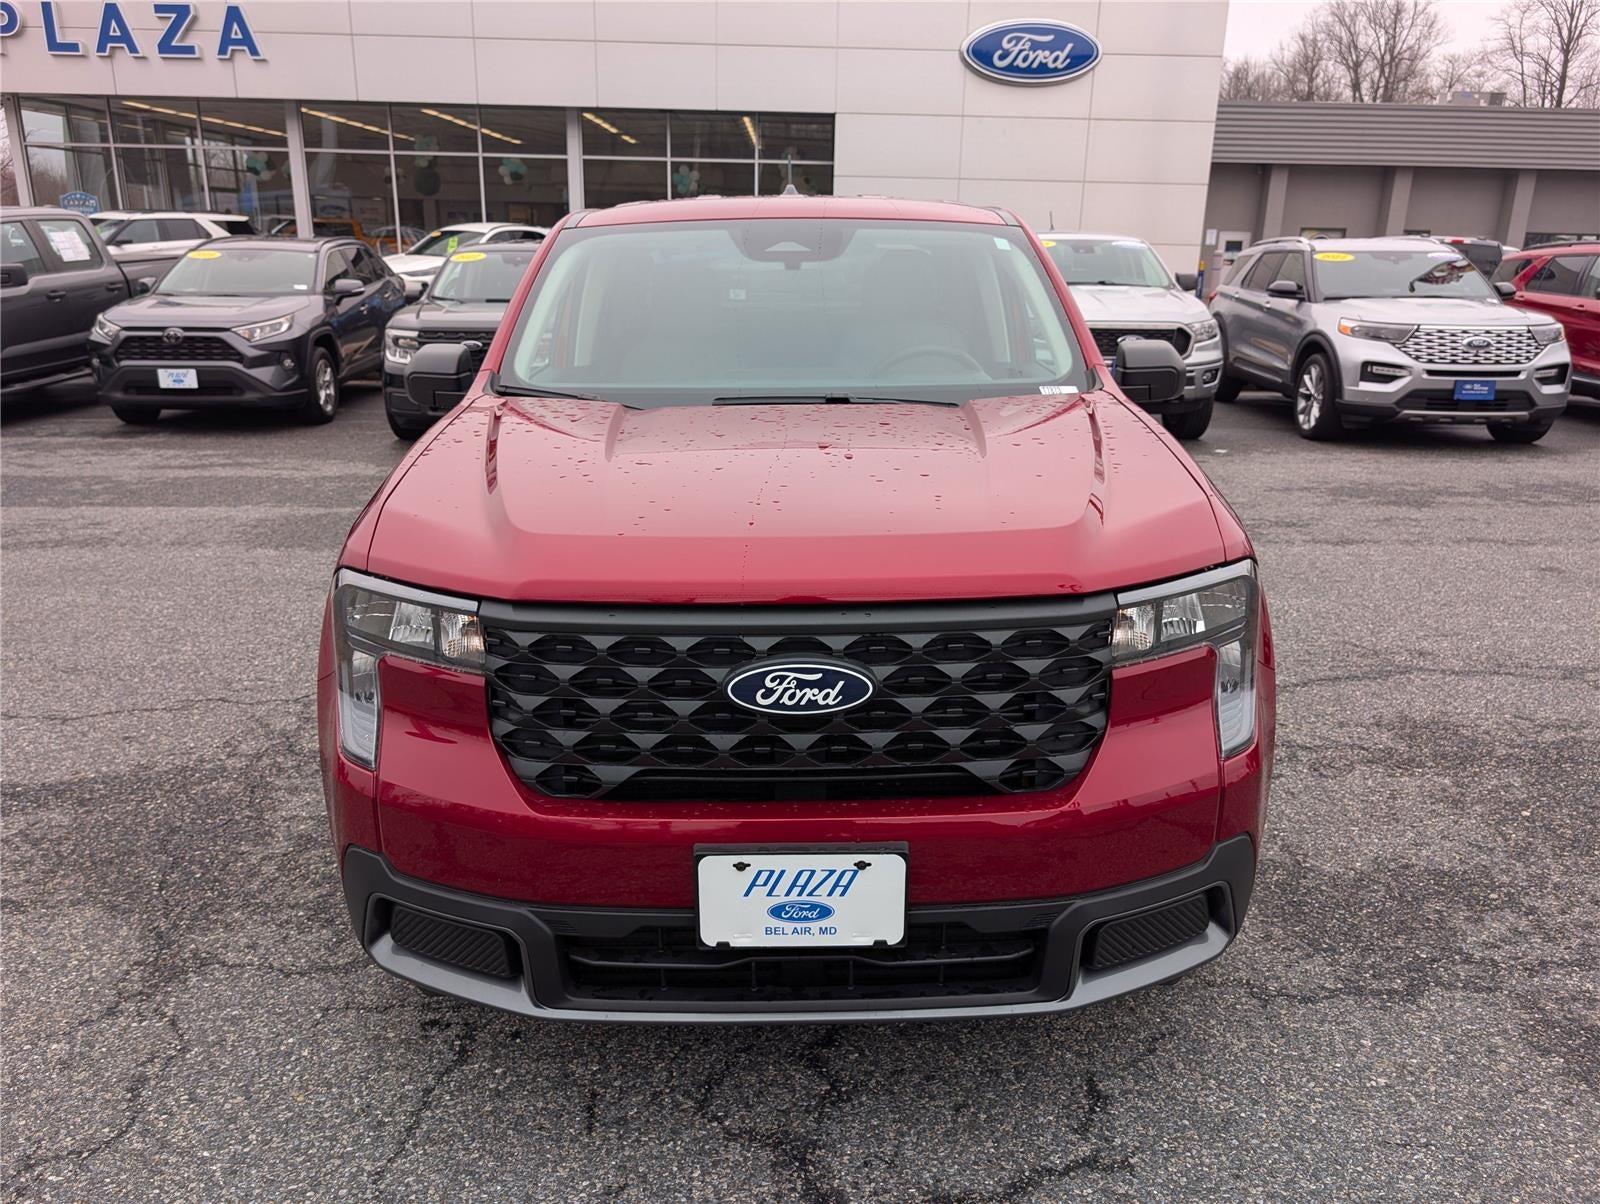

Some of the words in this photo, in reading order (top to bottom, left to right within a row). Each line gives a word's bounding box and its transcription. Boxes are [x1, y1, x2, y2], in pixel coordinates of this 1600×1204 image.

[992, 32, 1074, 69] Ford
[756, 671, 844, 706] Ford
[743, 869, 860, 897] PLAZA
[781, 903, 820, 919] Ford
[765, 926, 788, 936] BEL
[789, 926, 815, 937] AIR,
[819, 926, 837, 935] MD
